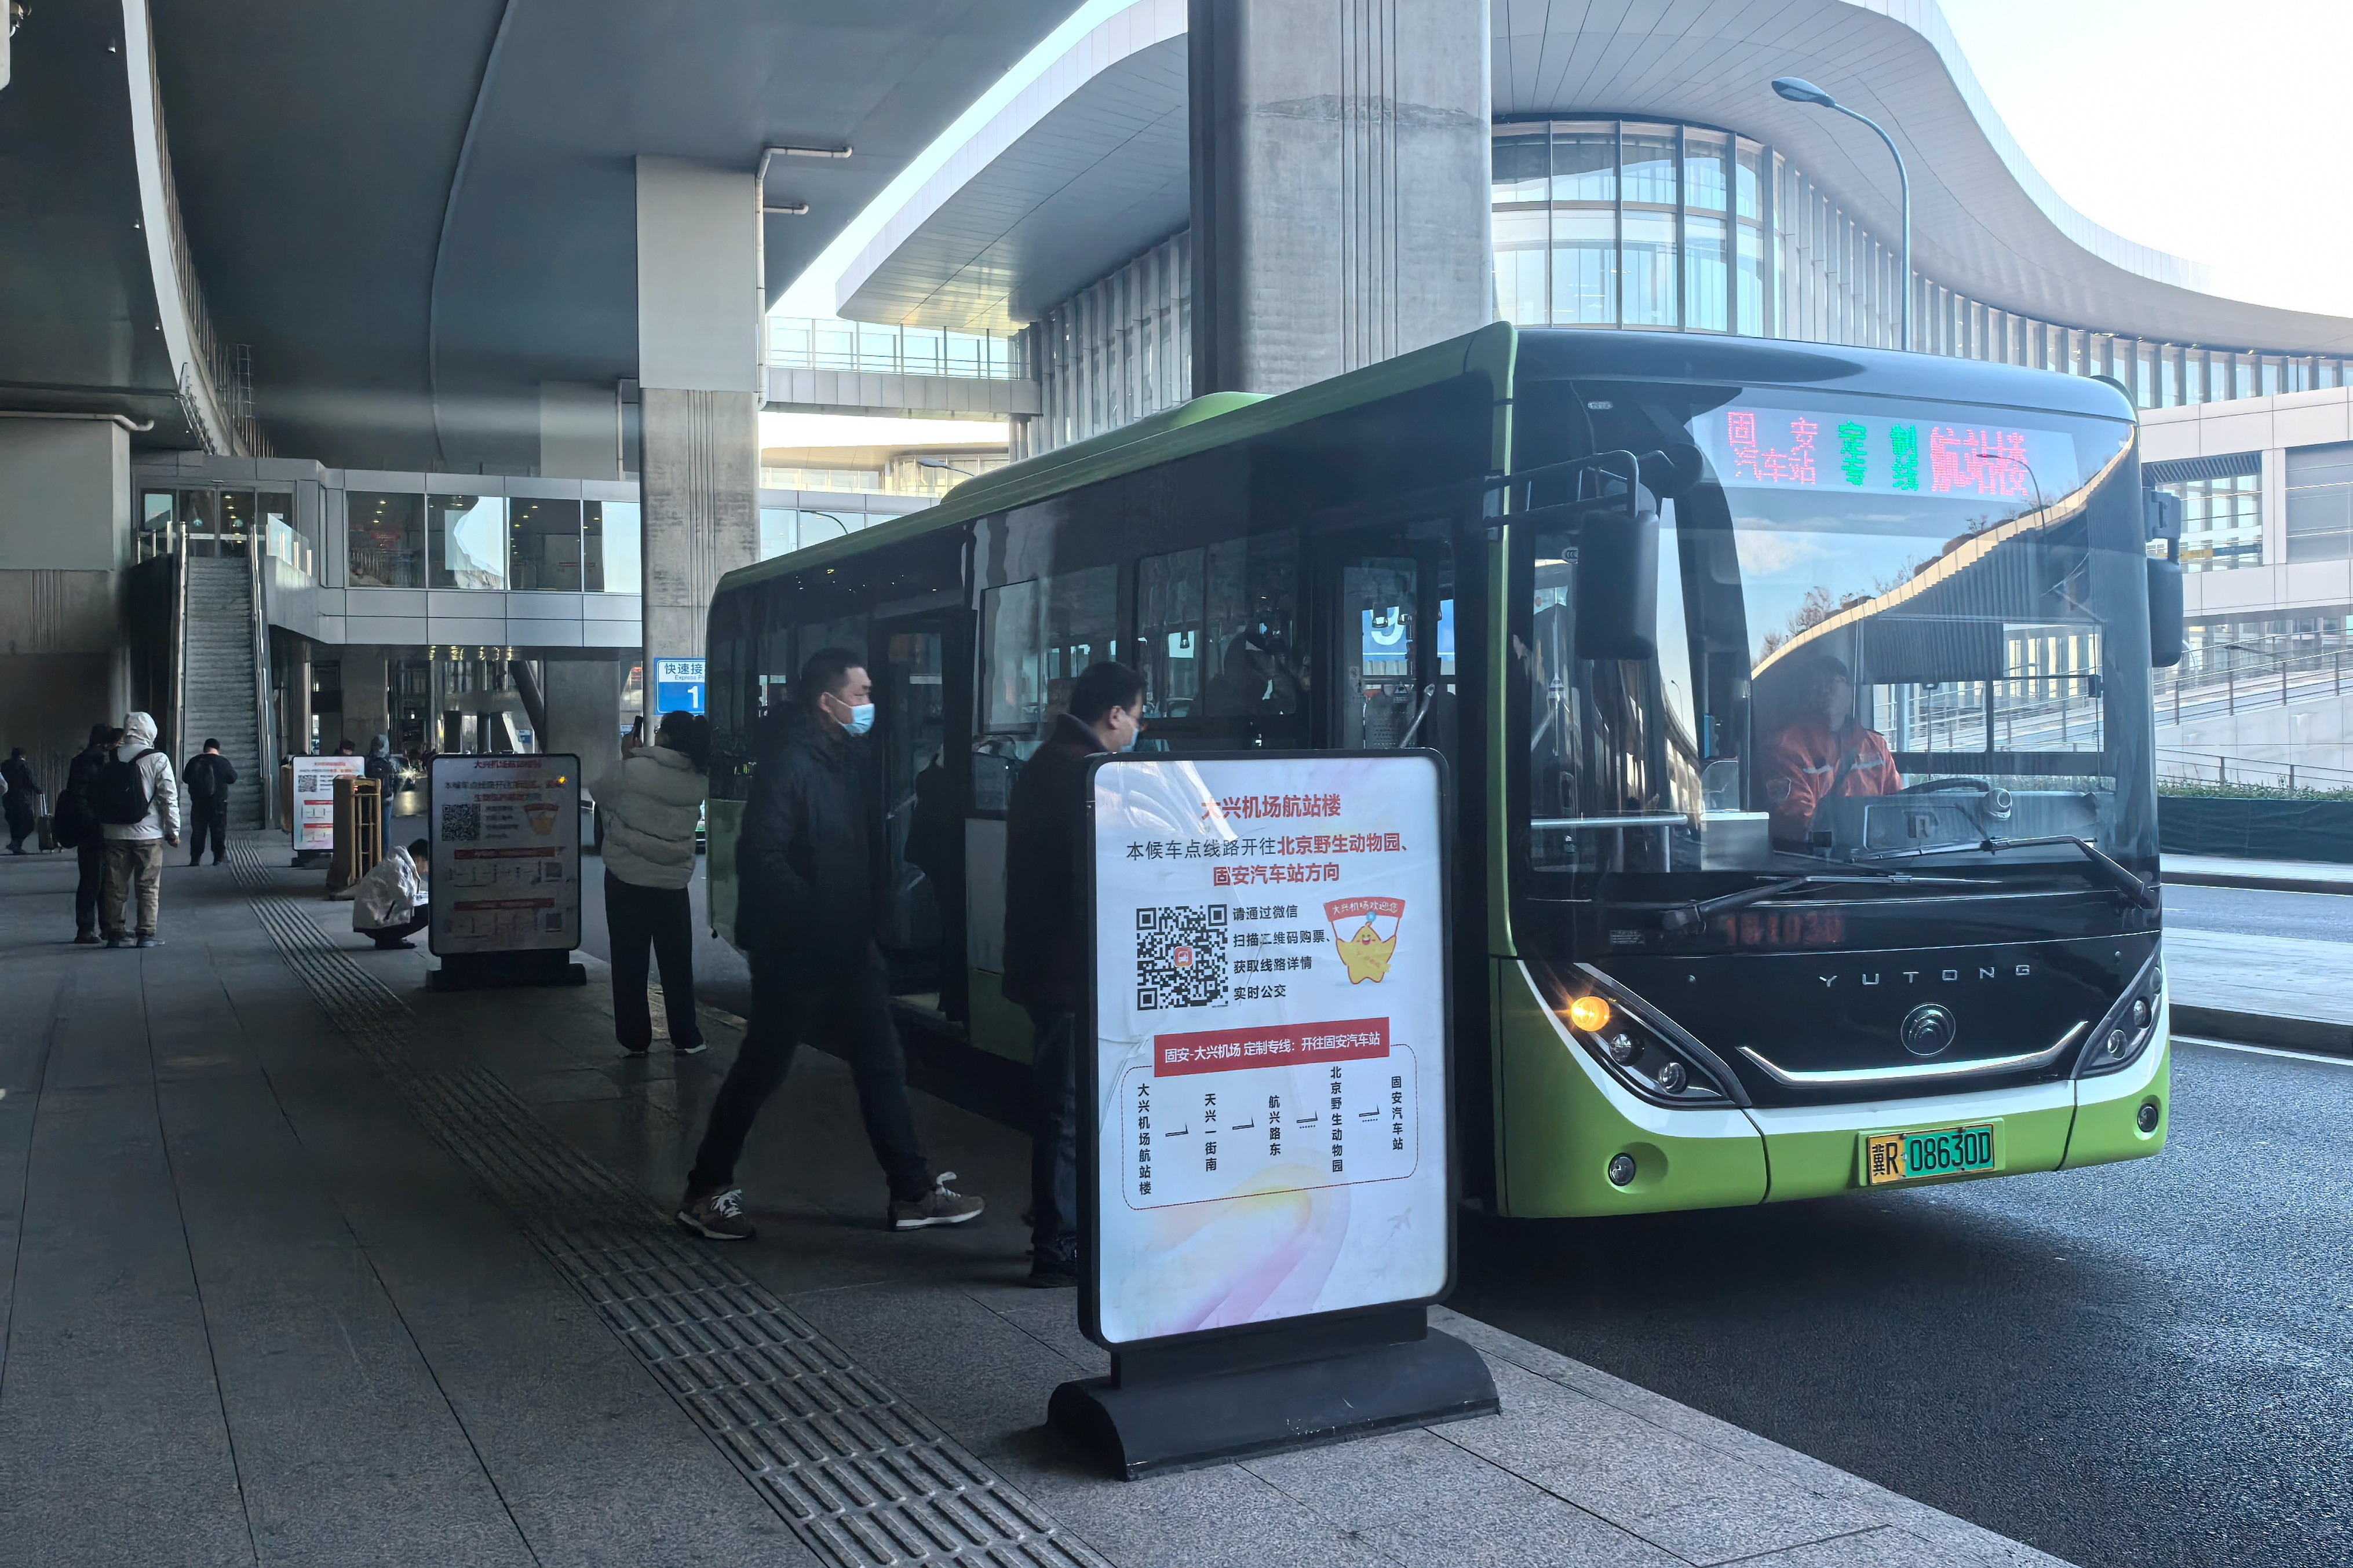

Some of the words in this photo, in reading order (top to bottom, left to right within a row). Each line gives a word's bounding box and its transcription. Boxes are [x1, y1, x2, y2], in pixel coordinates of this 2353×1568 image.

[1728, 412, 1818, 455] 固安
[1734, 447, 1816, 485] 汽车站
[1931, 427, 2028, 495] 航站楼
[664, 663, 703, 675] 快速接
[687, 685, 698, 708] 1
[1201, 793, 1341, 820] 大兴机场航站楼
[1126, 832, 1408, 860] 本候车点线路开往北京野生动物园、
[1213, 862, 1340, 887] 固安汽车站方向
[1232, 905, 1299, 922] 请通过微信
[1332, 900, 1398, 915] 大兴机场欢迎您
[1233, 929, 1331, 948] 扫描二维码购票、
[1234, 956, 1312, 974] 获取线路详情
[1819, 964, 2031, 987] YUTONG
[1234, 984, 1286, 1000] 实时公交
[1165, 1046, 1241, 1063] 固安-大兴机场
[1268, 1095, 1281, 1156] 航兴路东
[1330, 1066, 1344, 1174] 北京野生动物园
[1391, 1076, 1403, 1150] 固安汽车站
[1137, 1083, 1151, 1196] 大兴机场航站楼
[1205, 1093, 1217, 1172] 天兴一街南
[1911, 1131, 1993, 1172] 08630D
